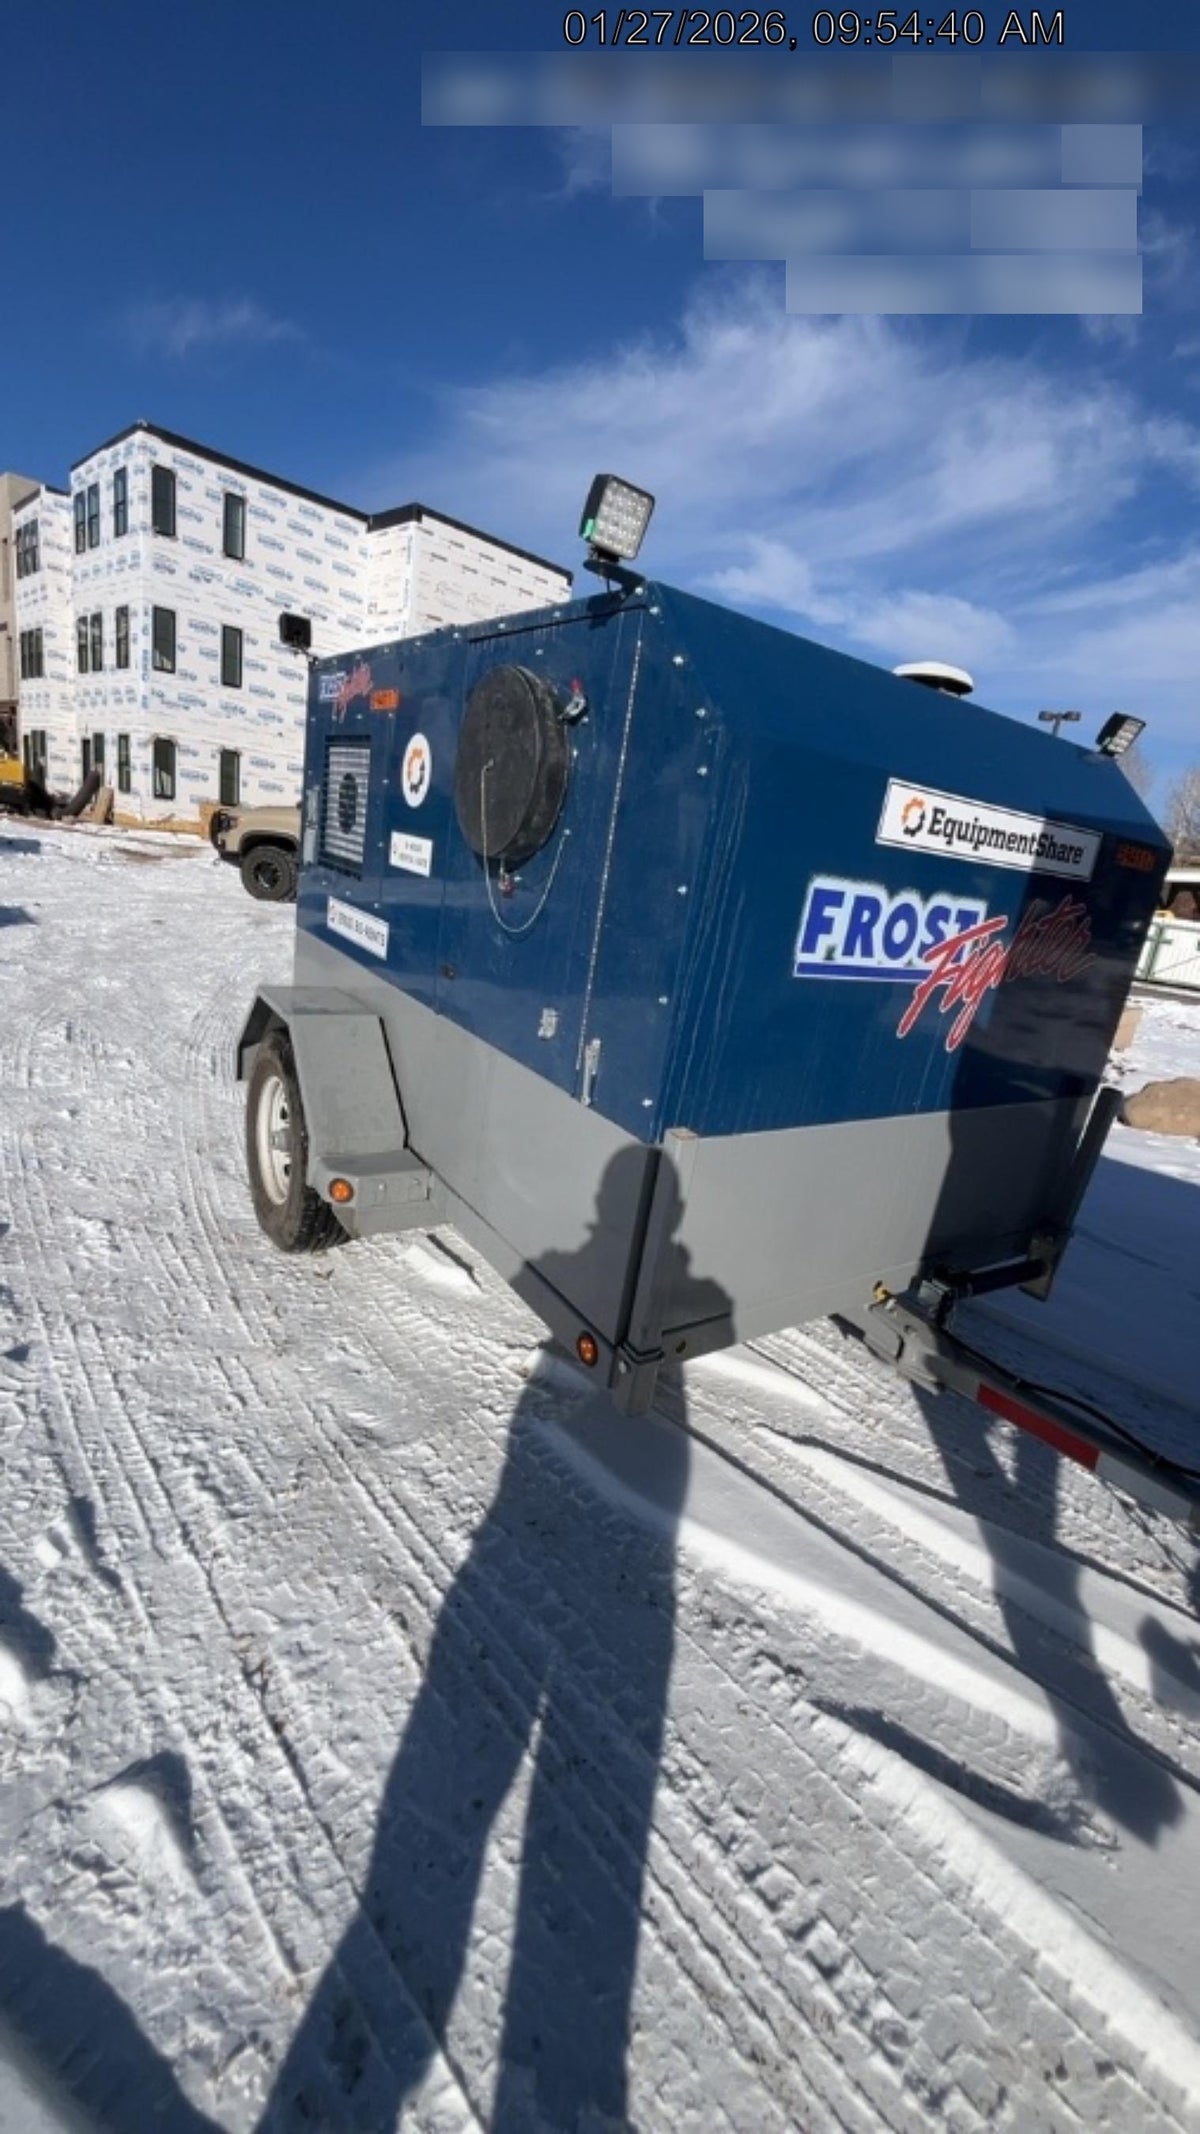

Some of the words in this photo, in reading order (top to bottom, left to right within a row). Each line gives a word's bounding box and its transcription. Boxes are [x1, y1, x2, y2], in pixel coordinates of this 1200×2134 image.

[926, 806, 1085, 865] EquipmentShare
[799, 885, 985, 962] FROST
[896, 894, 1097, 1052] Fighter
